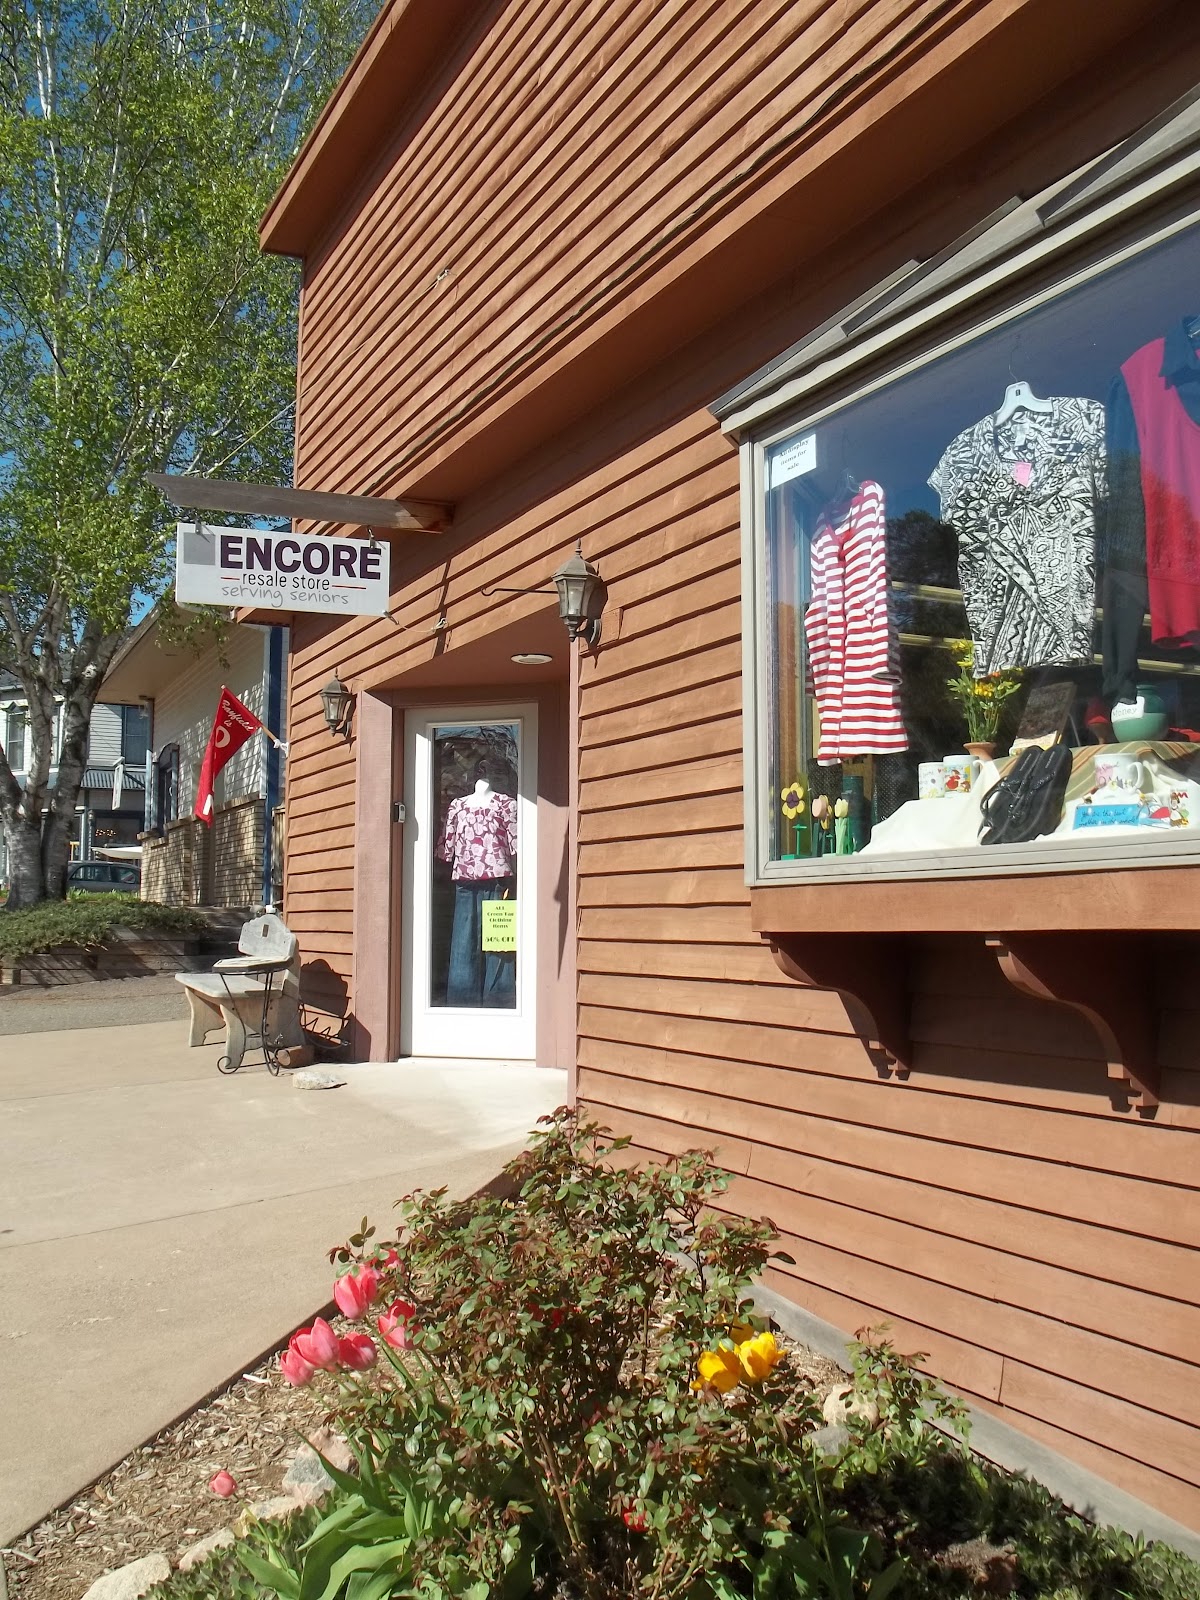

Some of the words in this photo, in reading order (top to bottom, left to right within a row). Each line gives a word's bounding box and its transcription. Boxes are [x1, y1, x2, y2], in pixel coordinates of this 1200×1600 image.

[780, 454, 797, 466] items
[787, 462, 800, 471] sale
[220, 534, 382, 580] ENCORE
[242, 571, 287, 588] resale
[292, 574, 330, 591] store
[221, 585, 284, 608] serving
[290, 590, 349, 605] seniors
[223, 719, 233, 728] is
